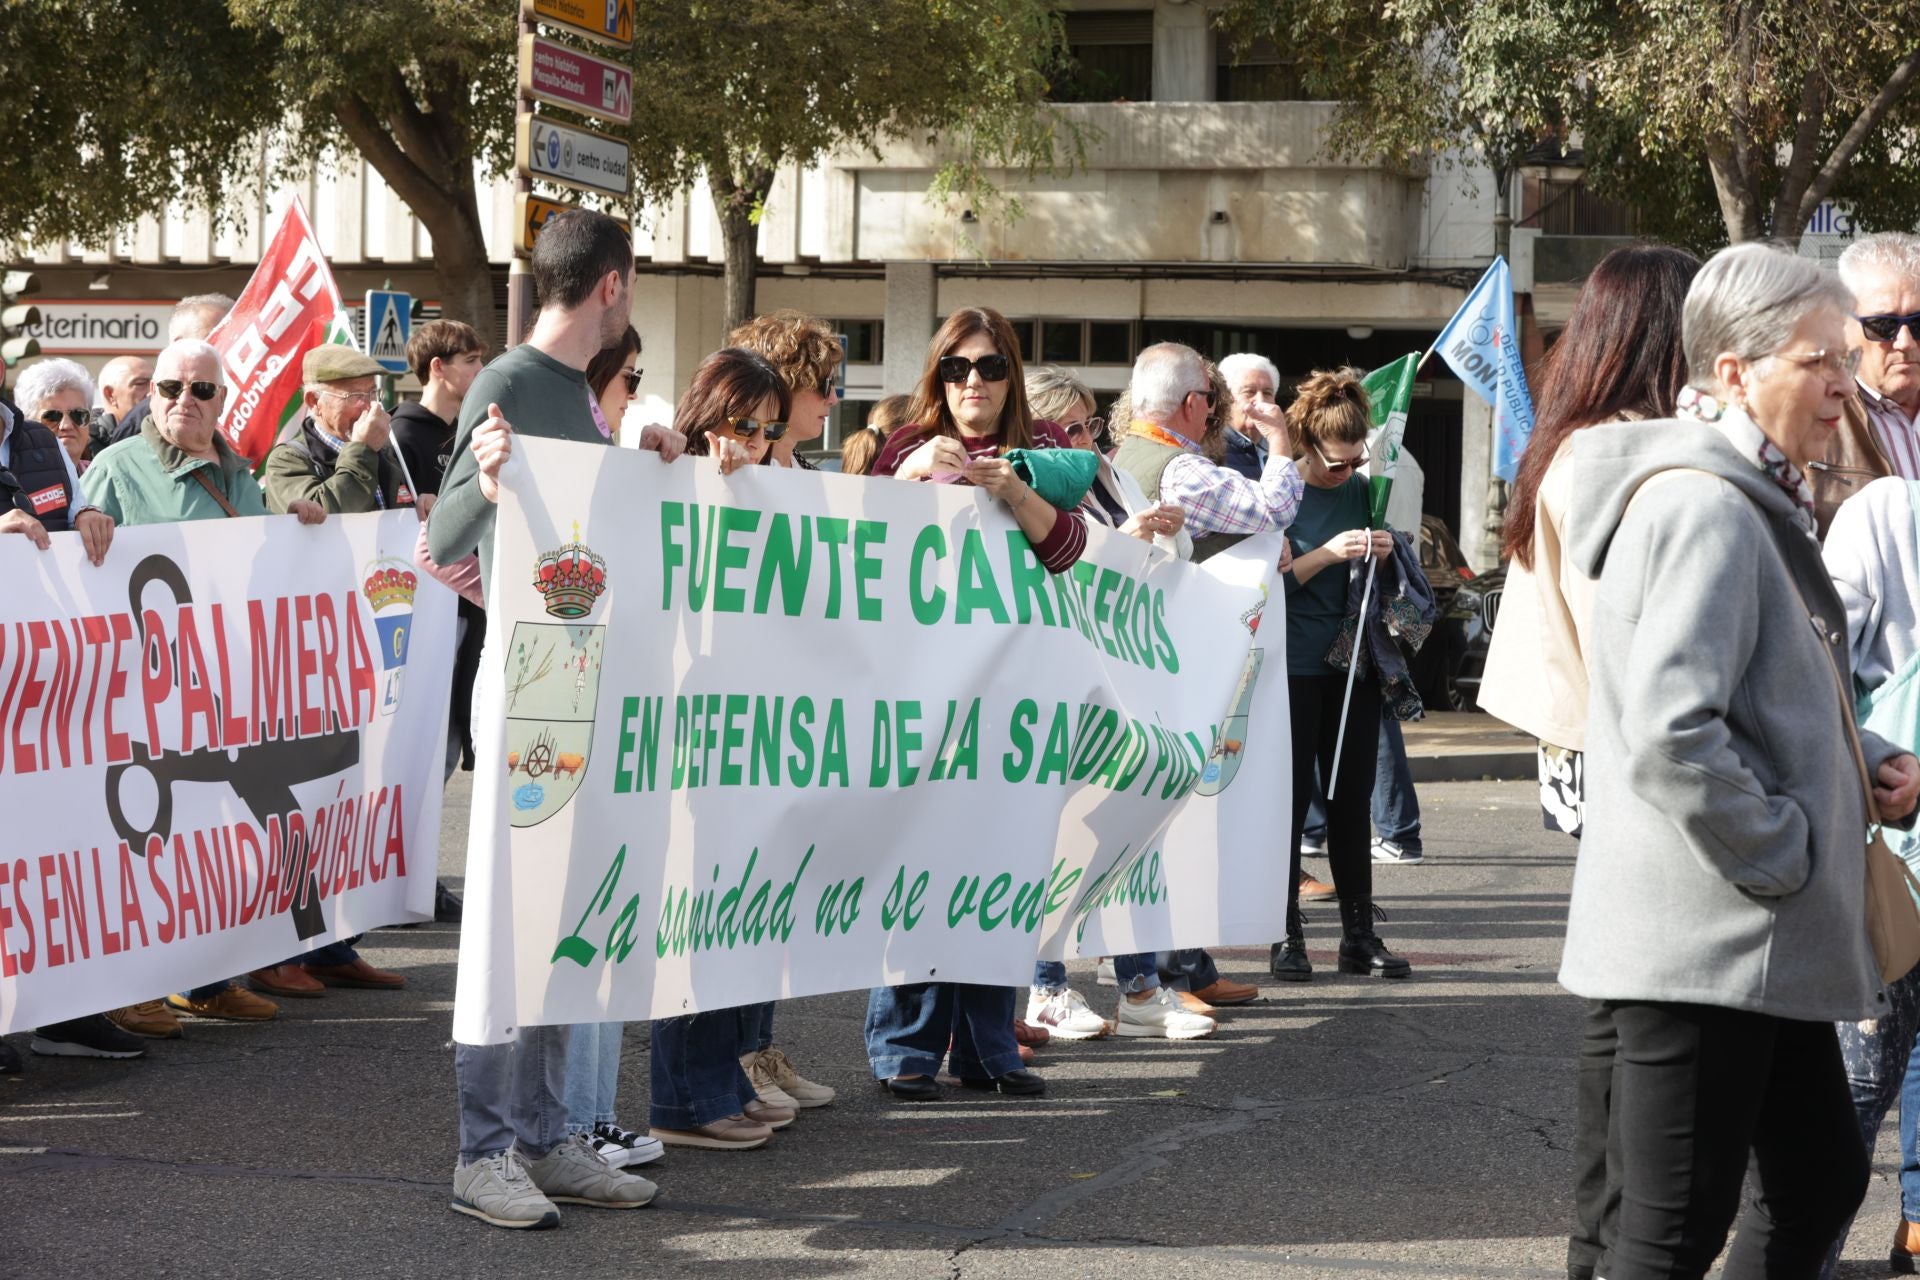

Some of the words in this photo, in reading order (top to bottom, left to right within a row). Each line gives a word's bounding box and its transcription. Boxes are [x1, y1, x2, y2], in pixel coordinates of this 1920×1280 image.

[576, 150, 601, 171] centro
[602, 155, 626, 177] ciudad
[660, 500, 888, 622] FUENTE
[142, 590, 376, 758] PALMERA
[613, 696, 663, 794] EN
[670, 695, 850, 790] DEFENSA
[869, 699, 923, 788] DE
[928, 697, 981, 782] LA
[0, 858, 36, 977] ES
[39, 850, 90, 968] EN
[91, 842, 149, 956] LA
[145, 813, 306, 944] SANIDAD
[301, 778, 407, 907] PÚBLICA
[550, 843, 639, 968] La
[656, 843, 816, 960] sanidad
[815, 876, 865, 938] no
[881, 864, 930, 932] se
